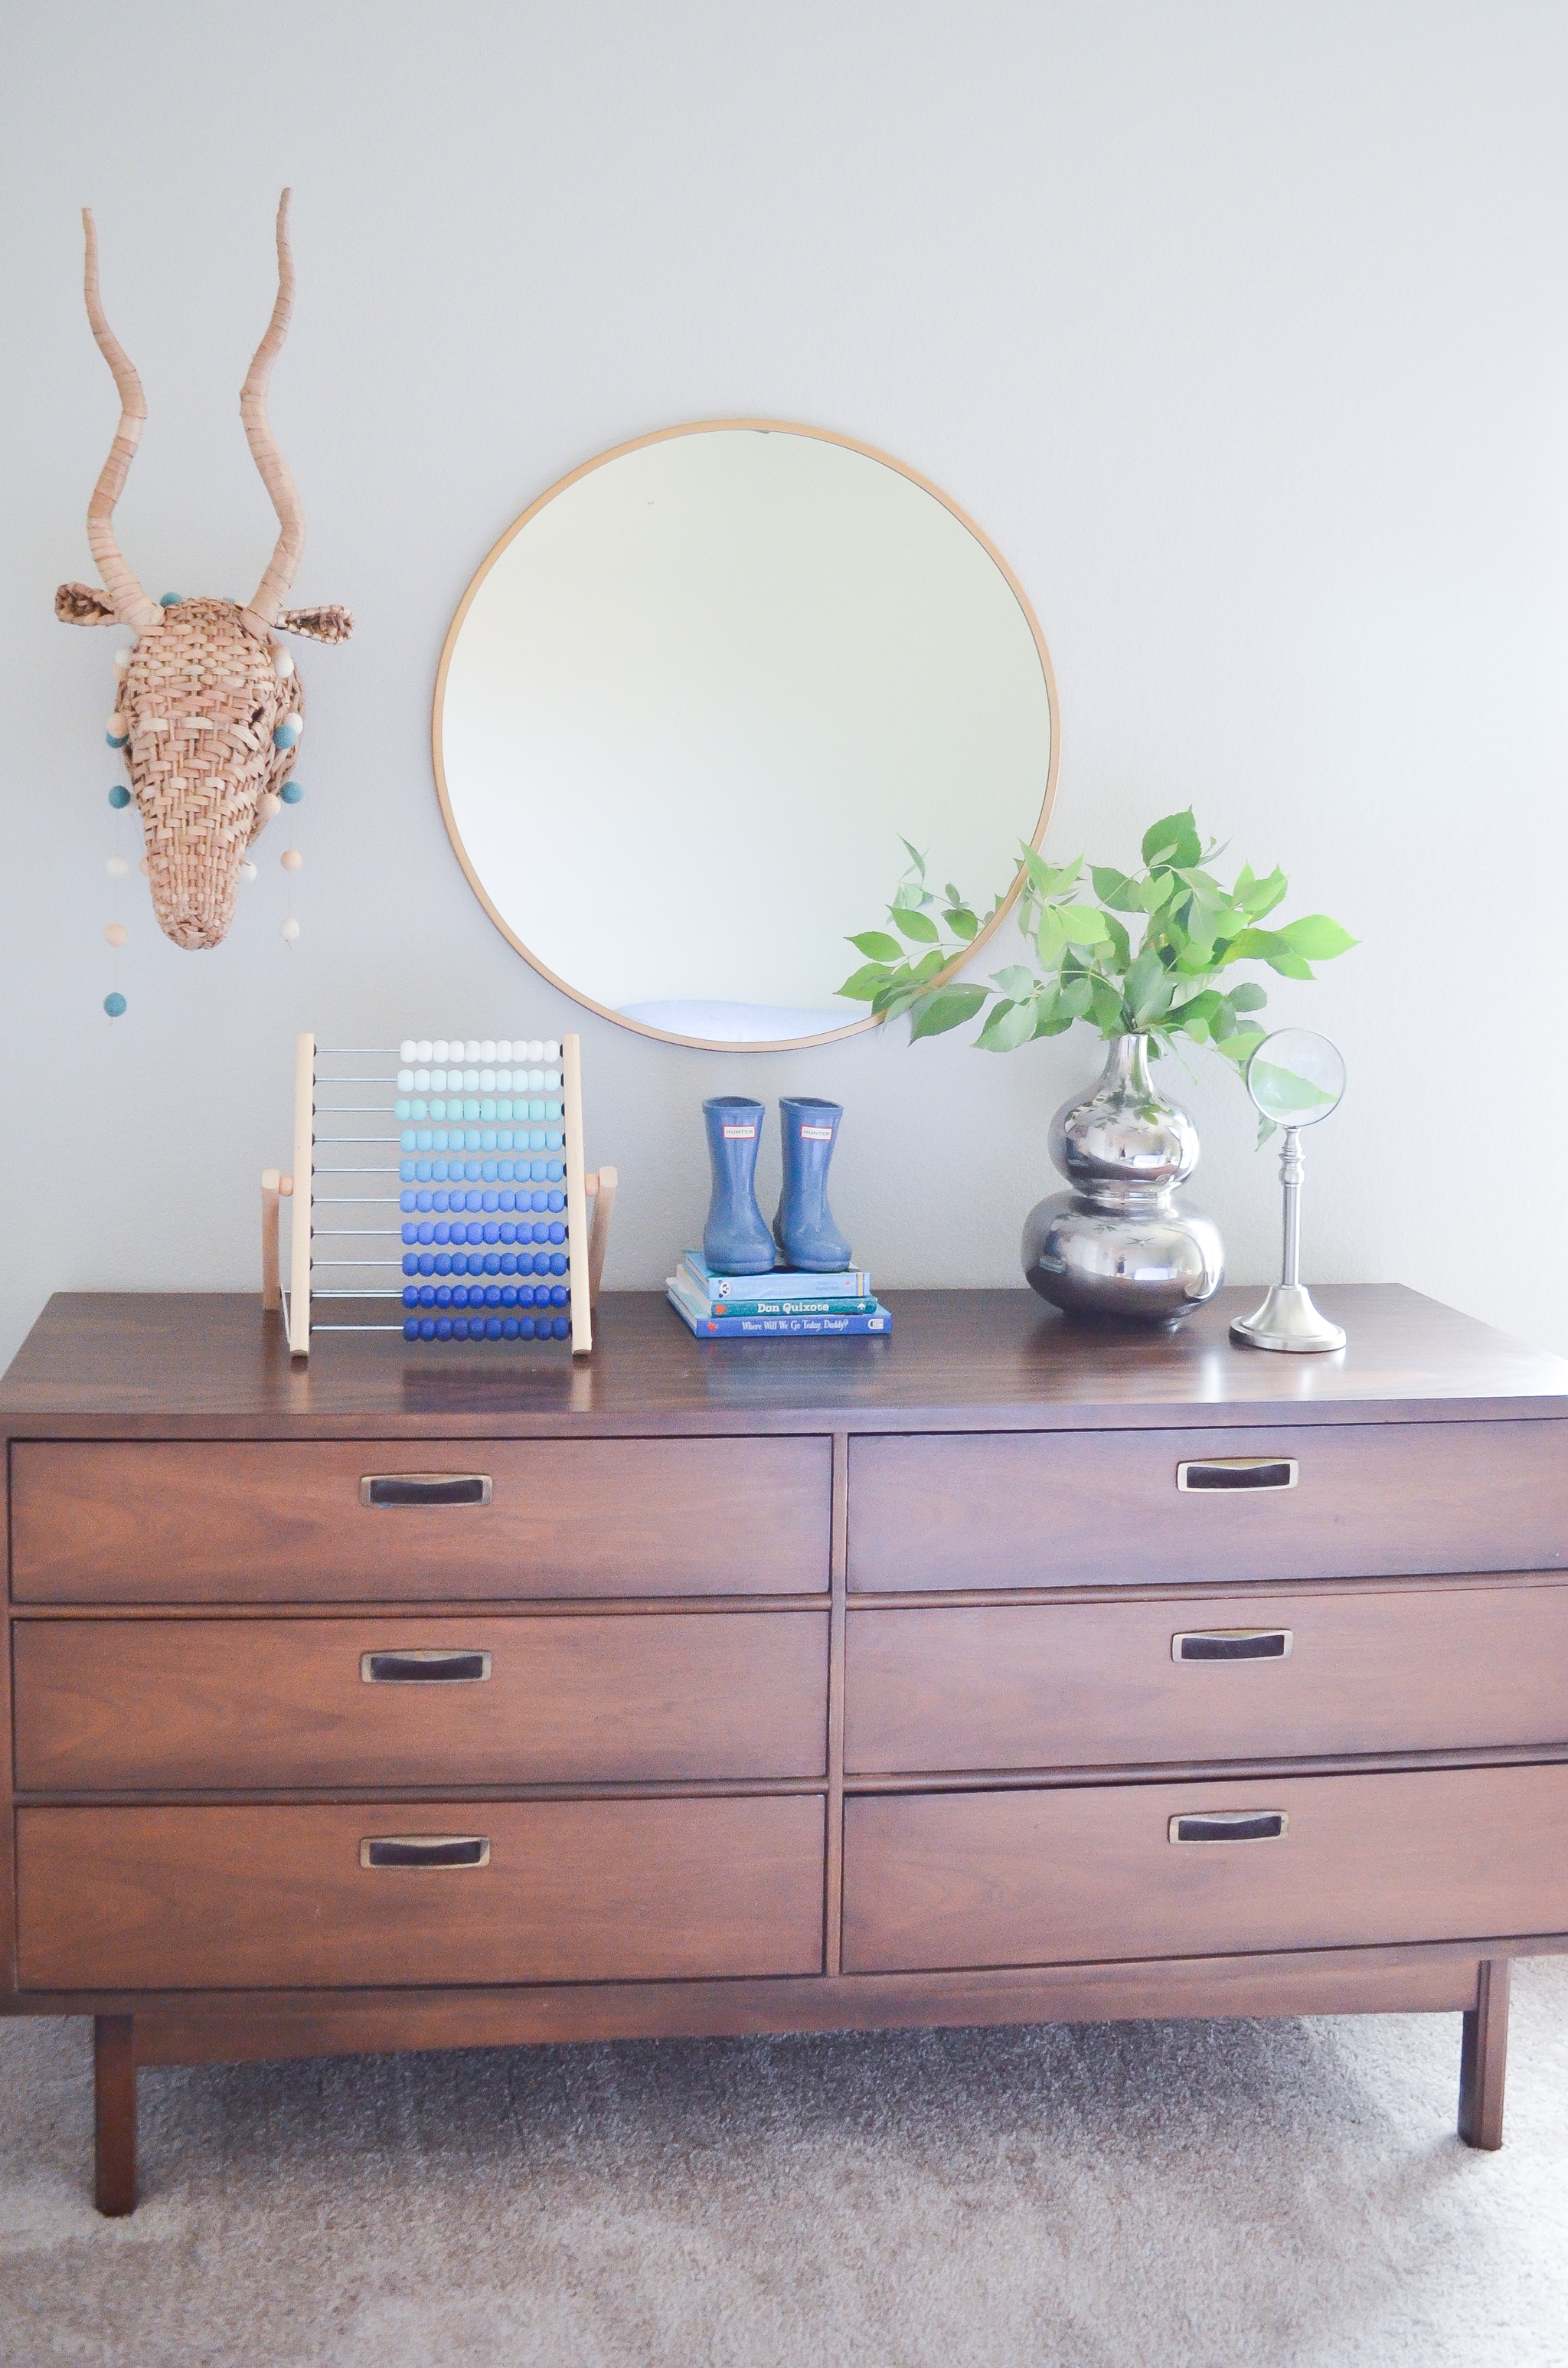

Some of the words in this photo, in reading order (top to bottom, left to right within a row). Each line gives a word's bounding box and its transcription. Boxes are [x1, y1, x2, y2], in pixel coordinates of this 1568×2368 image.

[757, 1303, 780, 1313] Don
[782, 1302, 829, 1314] Quixote
[742, 1321, 762, 1330] Where
[764, 1320, 777, 1330] Will
[779, 1320, 789, 1330] We
[791, 1320, 801, 1330] Go
[824, 1319, 849, 1331] Daddy?
